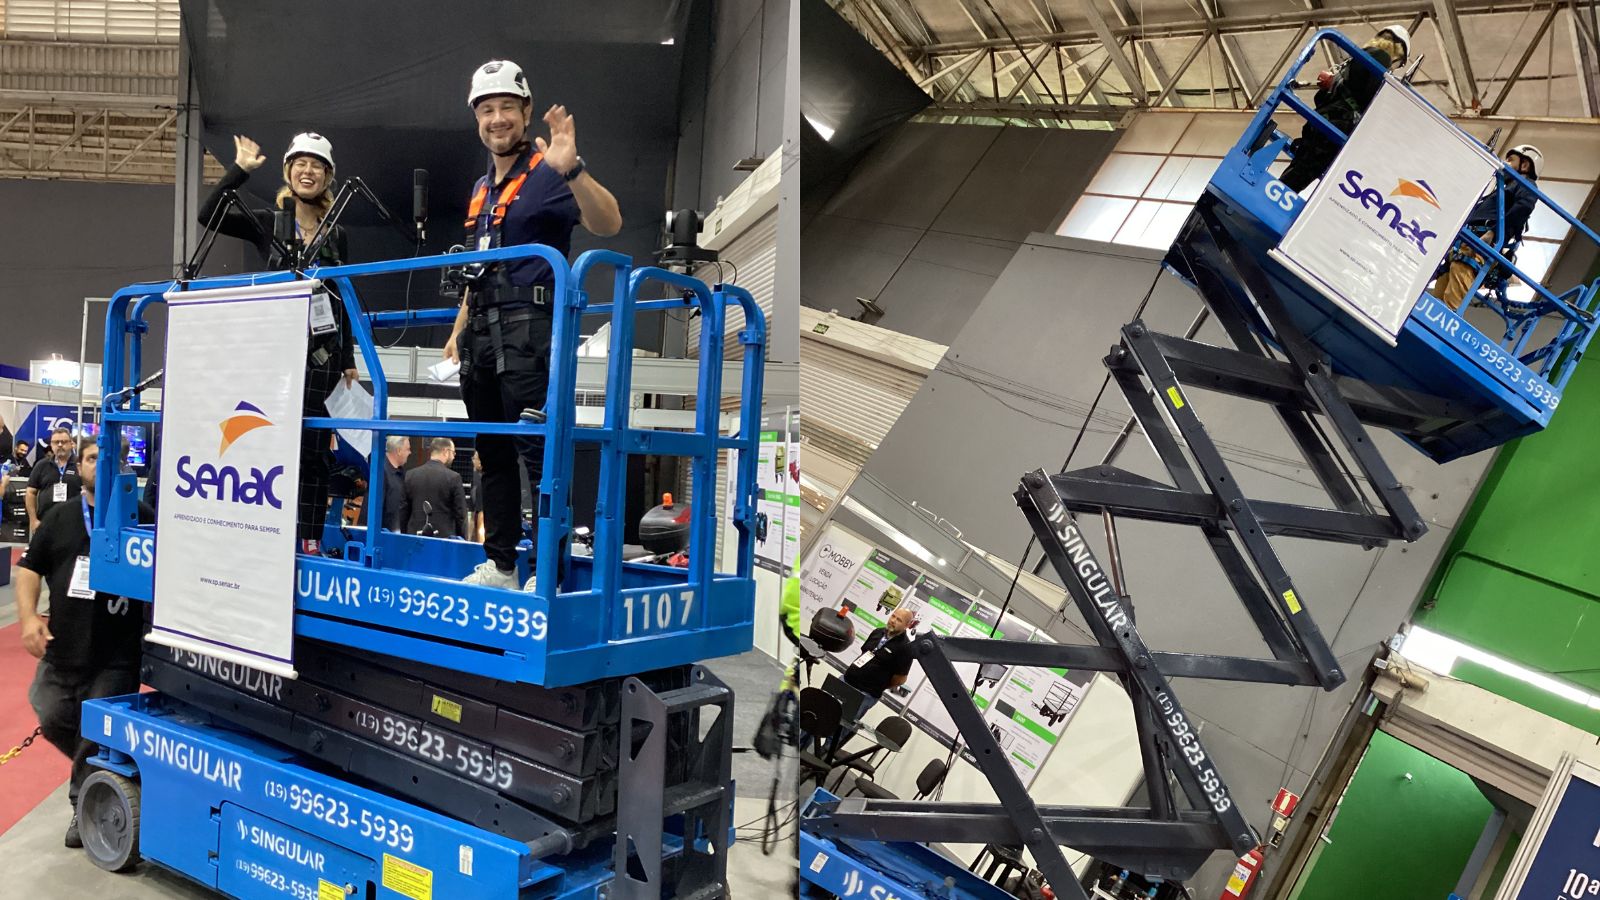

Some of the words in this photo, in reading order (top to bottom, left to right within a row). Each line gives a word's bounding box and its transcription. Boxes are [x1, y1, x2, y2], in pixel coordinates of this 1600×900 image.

[1265, 180, 1299, 211] GS
[1338, 169, 1438, 256] Senac
[1461, 330, 1480, 349] (19)
[1480, 343, 1560, 410] 99623-5939
[175, 455, 284, 510] Senac
[174, 512, 203, 524] APRENDIZADO
[207, 518, 244, 530] CONHECIMENTO
[244, 523, 259, 532] PARA
[200, 576, 241, 590] www.sp.senac.br
[828, 550, 855, 570] MOBBY
[1057, 525, 1127, 631] SINGULAR
[368, 585, 395, 609] (19)
[399, 586, 547, 641] 99623-5939
[623, 590, 695, 636] 1107
[187, 652, 283, 701] SINGULAR
[143, 730, 242, 792] SINGULAR
[355, 711, 380, 735] (19)
[382, 716, 514, 789] 99623-5939
[1156, 692, 1174, 715] (19)
[1167, 712, 1231, 813] 99623-5939
[264, 780, 288, 803] (19)
[289, 784, 414, 853] 99623-5939
[250, 826, 325, 873] SINGULAR
